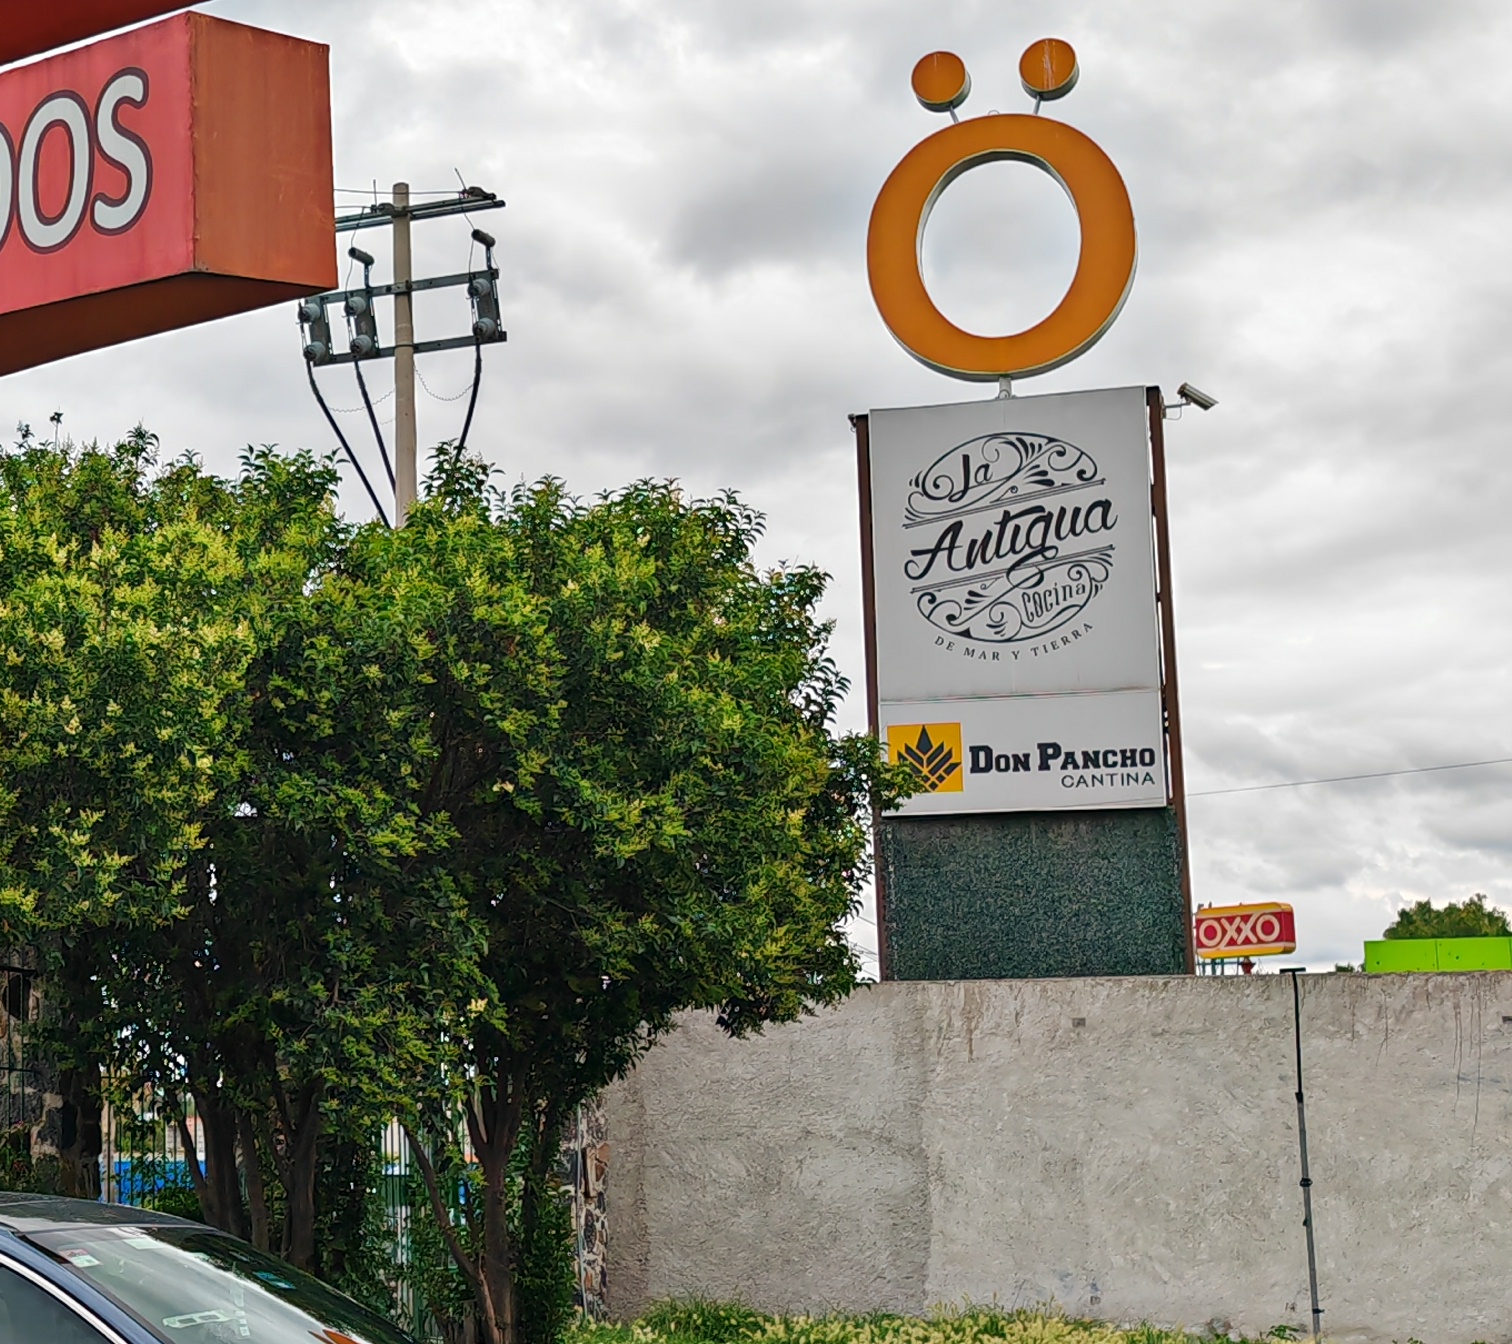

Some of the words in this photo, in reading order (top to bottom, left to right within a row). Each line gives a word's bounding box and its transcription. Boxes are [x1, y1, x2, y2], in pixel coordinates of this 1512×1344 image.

[904, 497, 1119, 589] Antigua
[934, 635, 956, 652] DE
[963, 646, 1000, 662] MAR
[1011, 649, 1021, 661] Y
[1030, 621, 1094, 657] TIERRA
[1060, 771, 1156, 789] CANTINA
[1198, 912, 1281, 950] OXXO
